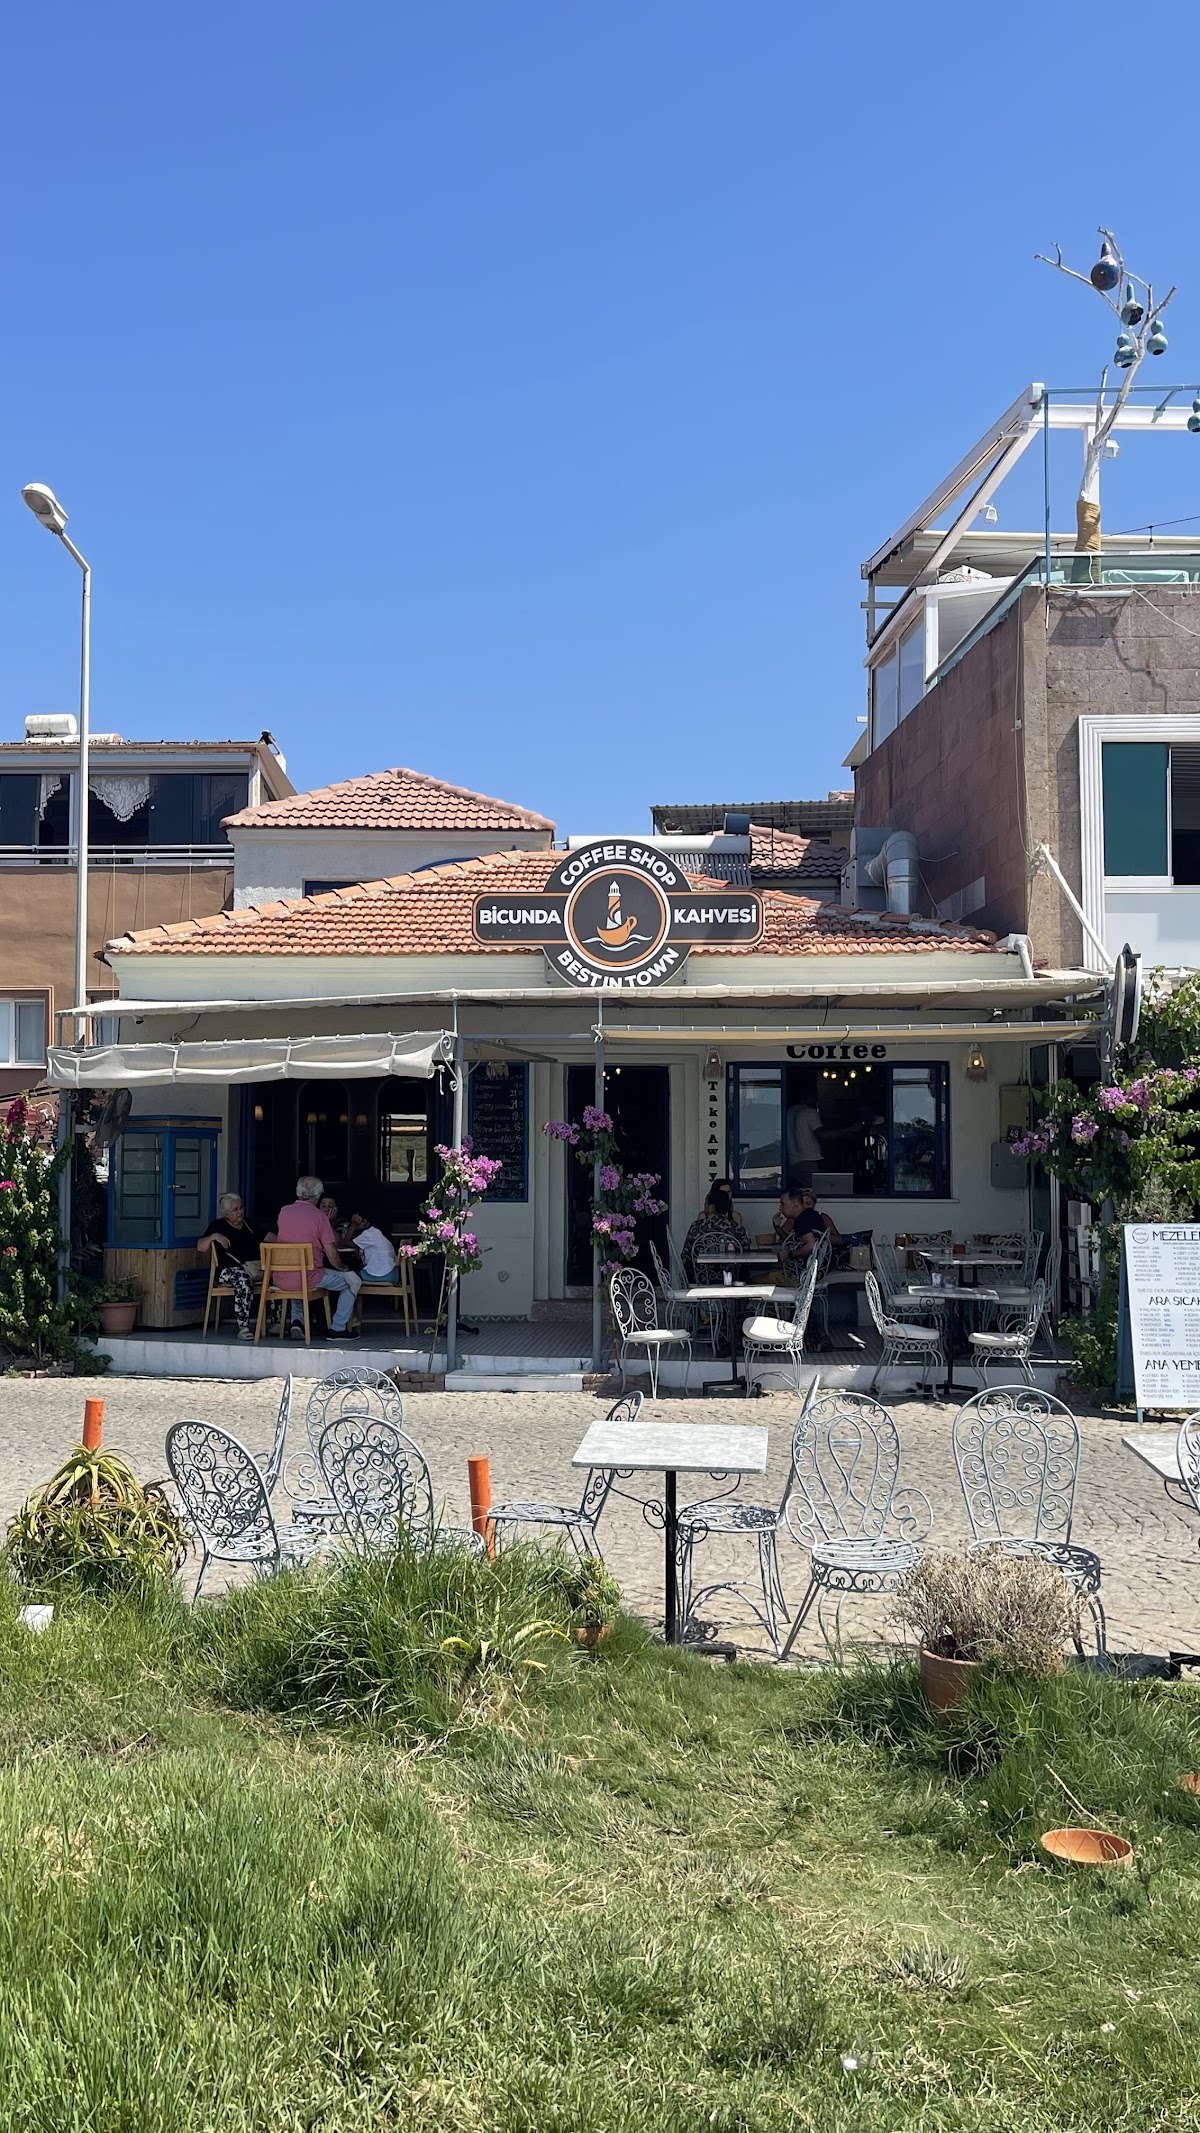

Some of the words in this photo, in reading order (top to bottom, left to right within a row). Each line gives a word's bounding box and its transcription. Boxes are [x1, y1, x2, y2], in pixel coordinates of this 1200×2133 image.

[560, 845, 627, 887] COFFEE
[628, 846, 677, 887] SHOP
[479, 905, 562, 925] BİCUNDA
[674, 904, 757, 924] KAHVESİ
[556, 949, 600, 987] BEST
[601, 976, 623, 987] IN
[625, 947, 680, 987] TOWN
[1152, 1231, 1200, 1241] MEZELE
[1148, 1296, 1171, 1306] ARA
[1145, 1359, 1170, 1370] ANA
